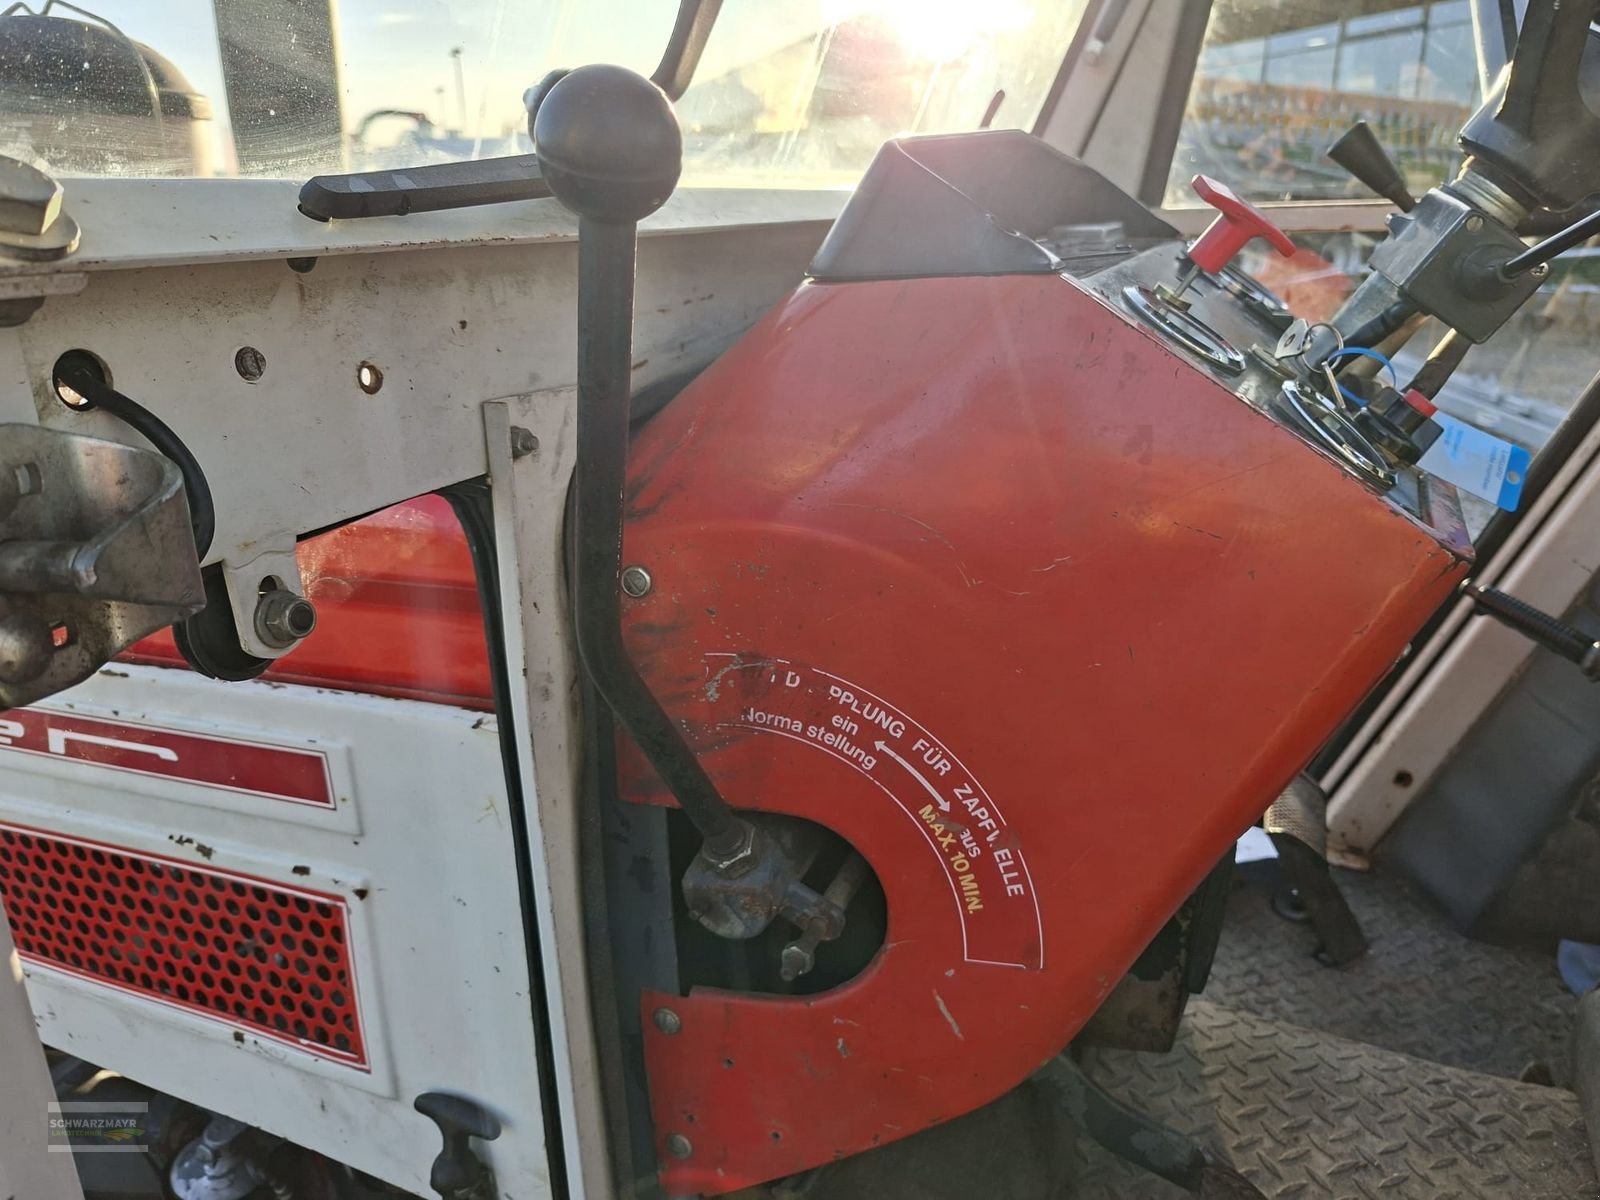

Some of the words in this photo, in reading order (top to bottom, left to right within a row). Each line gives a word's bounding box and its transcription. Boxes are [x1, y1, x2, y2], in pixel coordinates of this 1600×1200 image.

[831, 711, 859, 736] ein
[912, 738, 952, 777] FÜR
[918, 804, 957, 852] MAX.
[958, 873, 984, 914] MIN.
[959, 828, 981, 858] aus
